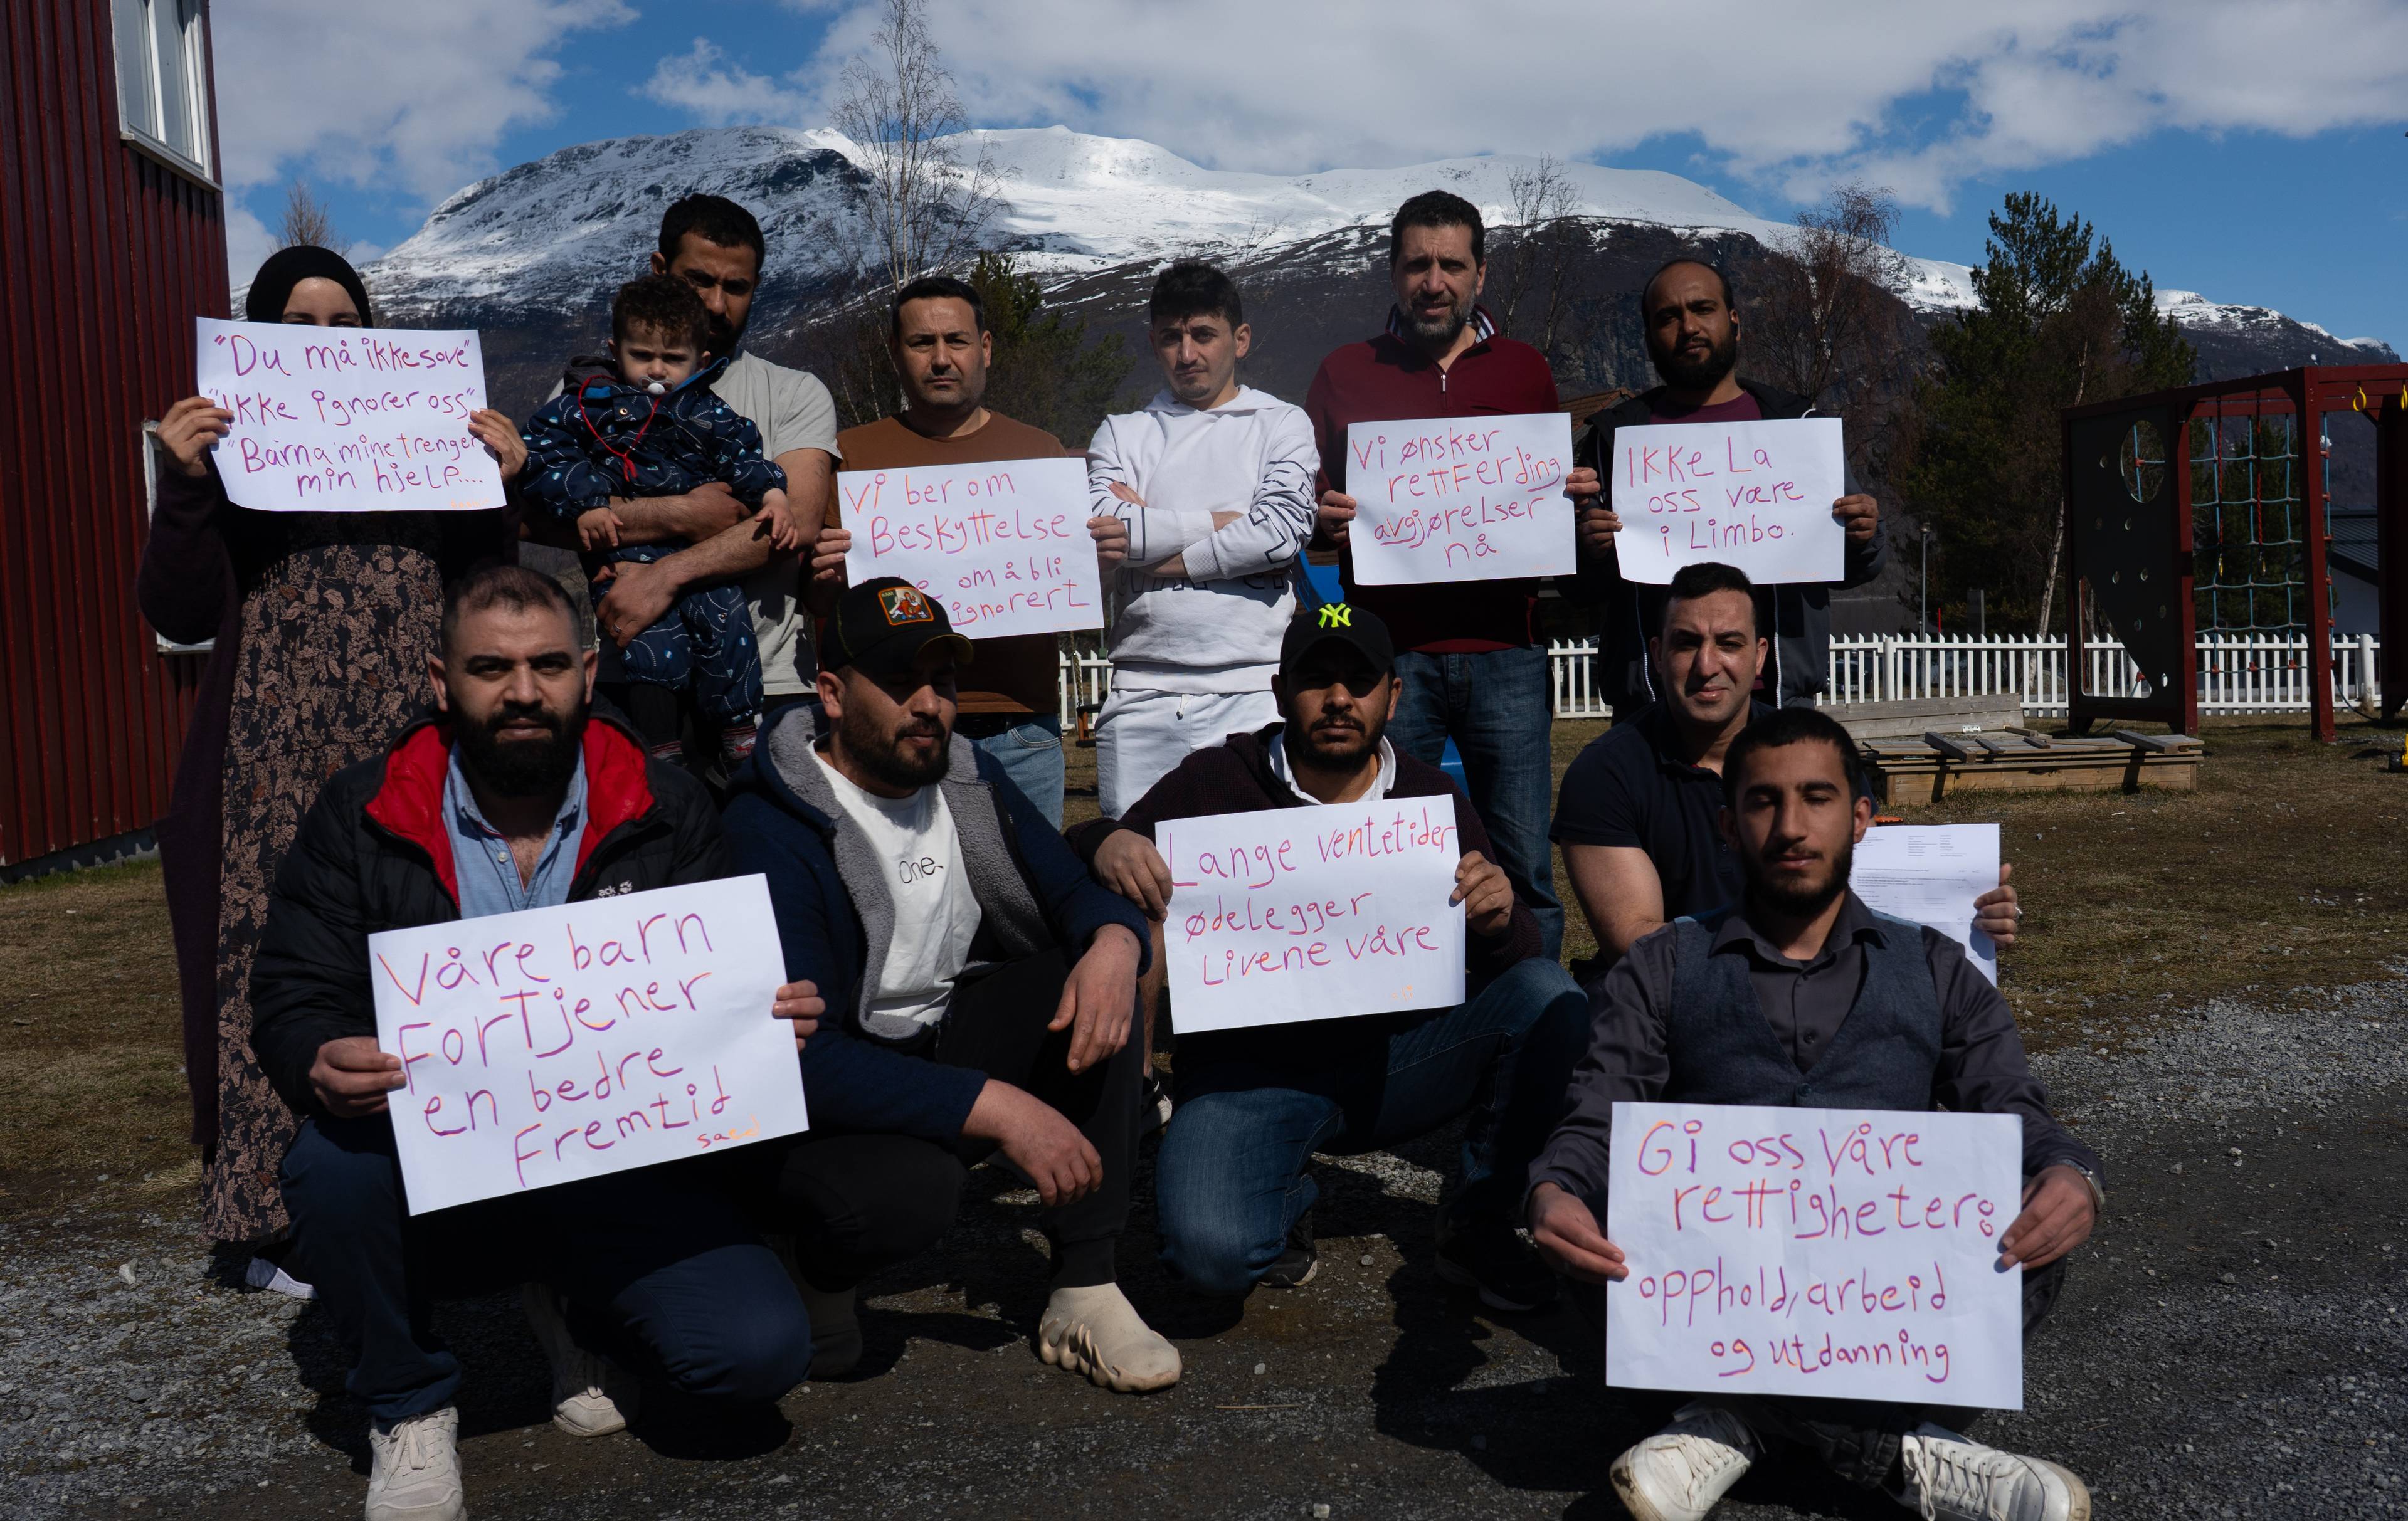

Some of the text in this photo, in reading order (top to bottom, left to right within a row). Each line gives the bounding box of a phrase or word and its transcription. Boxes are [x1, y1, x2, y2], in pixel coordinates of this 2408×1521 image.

[306, 340, 357, 372] må
[362, 337, 419, 371] ikke
[312, 390, 419, 426] ignorer
[334, 434, 395, 463] mine
[396, 433, 480, 461] trenger
[1400, 427, 1502, 465] ønsker
[297, 468, 357, 497] min
[905, 475, 953, 505] ber
[968, 473, 1015, 497] om
[1649, 480, 1805, 513] oss være
[1443, 532, 1497, 569] nå
[1659, 514, 1795, 557] i Limbo.
[958, 569, 996, 589] om
[1005, 561, 1022, 581] å
[1030, 556, 1062, 579] bli
[951, 579, 1090, 627] ignorert
[1169, 806, 1456, 889] Lange ventetider
[1185, 892, 1373, 944] ødelegger
[378, 913, 713, 1006] Våre barn
[1203, 925, 1439, 986] Livene våre
[425, 1048, 684, 1137] en bedre
[514, 1065, 731, 1188] Fremtid
[1638, 1120, 1703, 1176] Gi
[1729, 1134, 1805, 1170] oss
[1710, 1328, 1950, 1384] og utdanning
